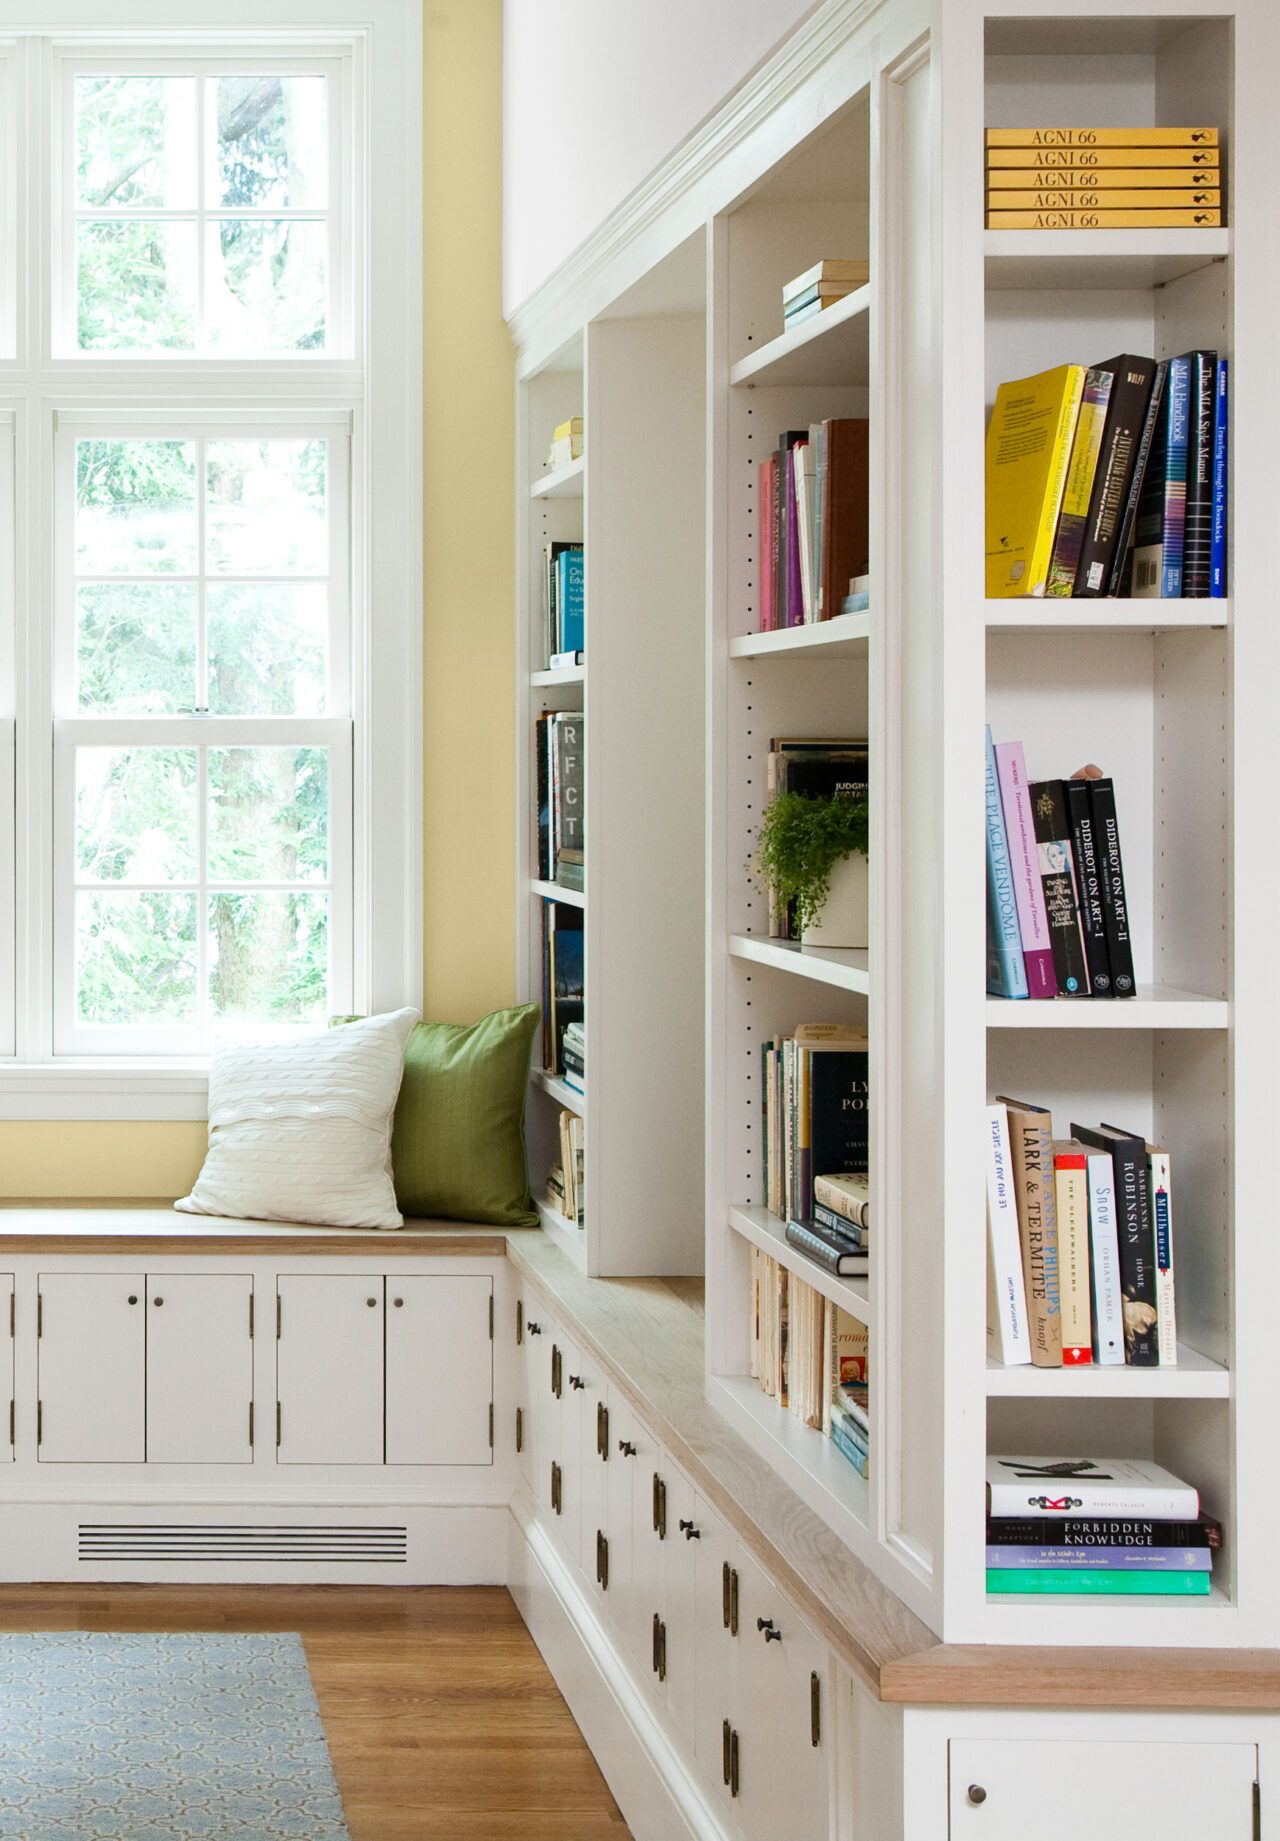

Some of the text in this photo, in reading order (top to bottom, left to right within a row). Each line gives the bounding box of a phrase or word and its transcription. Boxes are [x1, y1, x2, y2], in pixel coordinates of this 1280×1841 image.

[1032, 130, 1096, 144] AGNI 66
[1033, 151, 1098, 166] AGNI 66
[1033, 172, 1098, 186] AGNI 66
[1033, 192, 1098, 206] AGNI 66
[1034, 213, 1098, 227] AGNI 66
[1126, 371, 1146, 387] WOLFF
[1173, 364, 1188, 442] MLA Handbook
[1196, 368, 1212, 484] The MLA Style Manual
[1216, 425, 1226, 460] Traveling
[1102, 436, 1132, 536] INVENTING EASTERN EUROPE
[1214, 460, 1224, 490] through
[1216, 492, 1224, 503] the
[1214, 505, 1223, 544] Boondocks
[987, 804, 1002, 852] PLACE
[1016, 792, 1025, 823] Territorial
[1025, 878, 1034, 901] gardens
[1081, 820, 1094, 873] DIDEROT
[1089, 880, 1097, 896] ON
[1105, 819, 1126, 941] DIDEROT ON ART II
[992, 856, 1018, 942] VENDÔME
[1090, 900, 1100, 923] ART
[996, 1168, 1005, 1180] AU
[1138, 1169, 1149, 1231] MARILYNNE
[1023, 1127, 1048, 1352] LARK & TERMITE knopf
[1040, 1128, 1060, 1315] JAYNE ANNE PHILLIPS
[1124, 1162, 1144, 1288] ROBINSON HOME
[1157, 1198, 1166, 1264] Millhauser
[1096, 1188, 1111, 1226] Snow
[1105, 1288, 1113, 1324] PAMUK
[1163, 1283, 1171, 1316] Martin
[1064, 1522, 1152, 1533] FORBIDDEN
[1064, 1534, 1153, 1546] KNOWLEDGE
